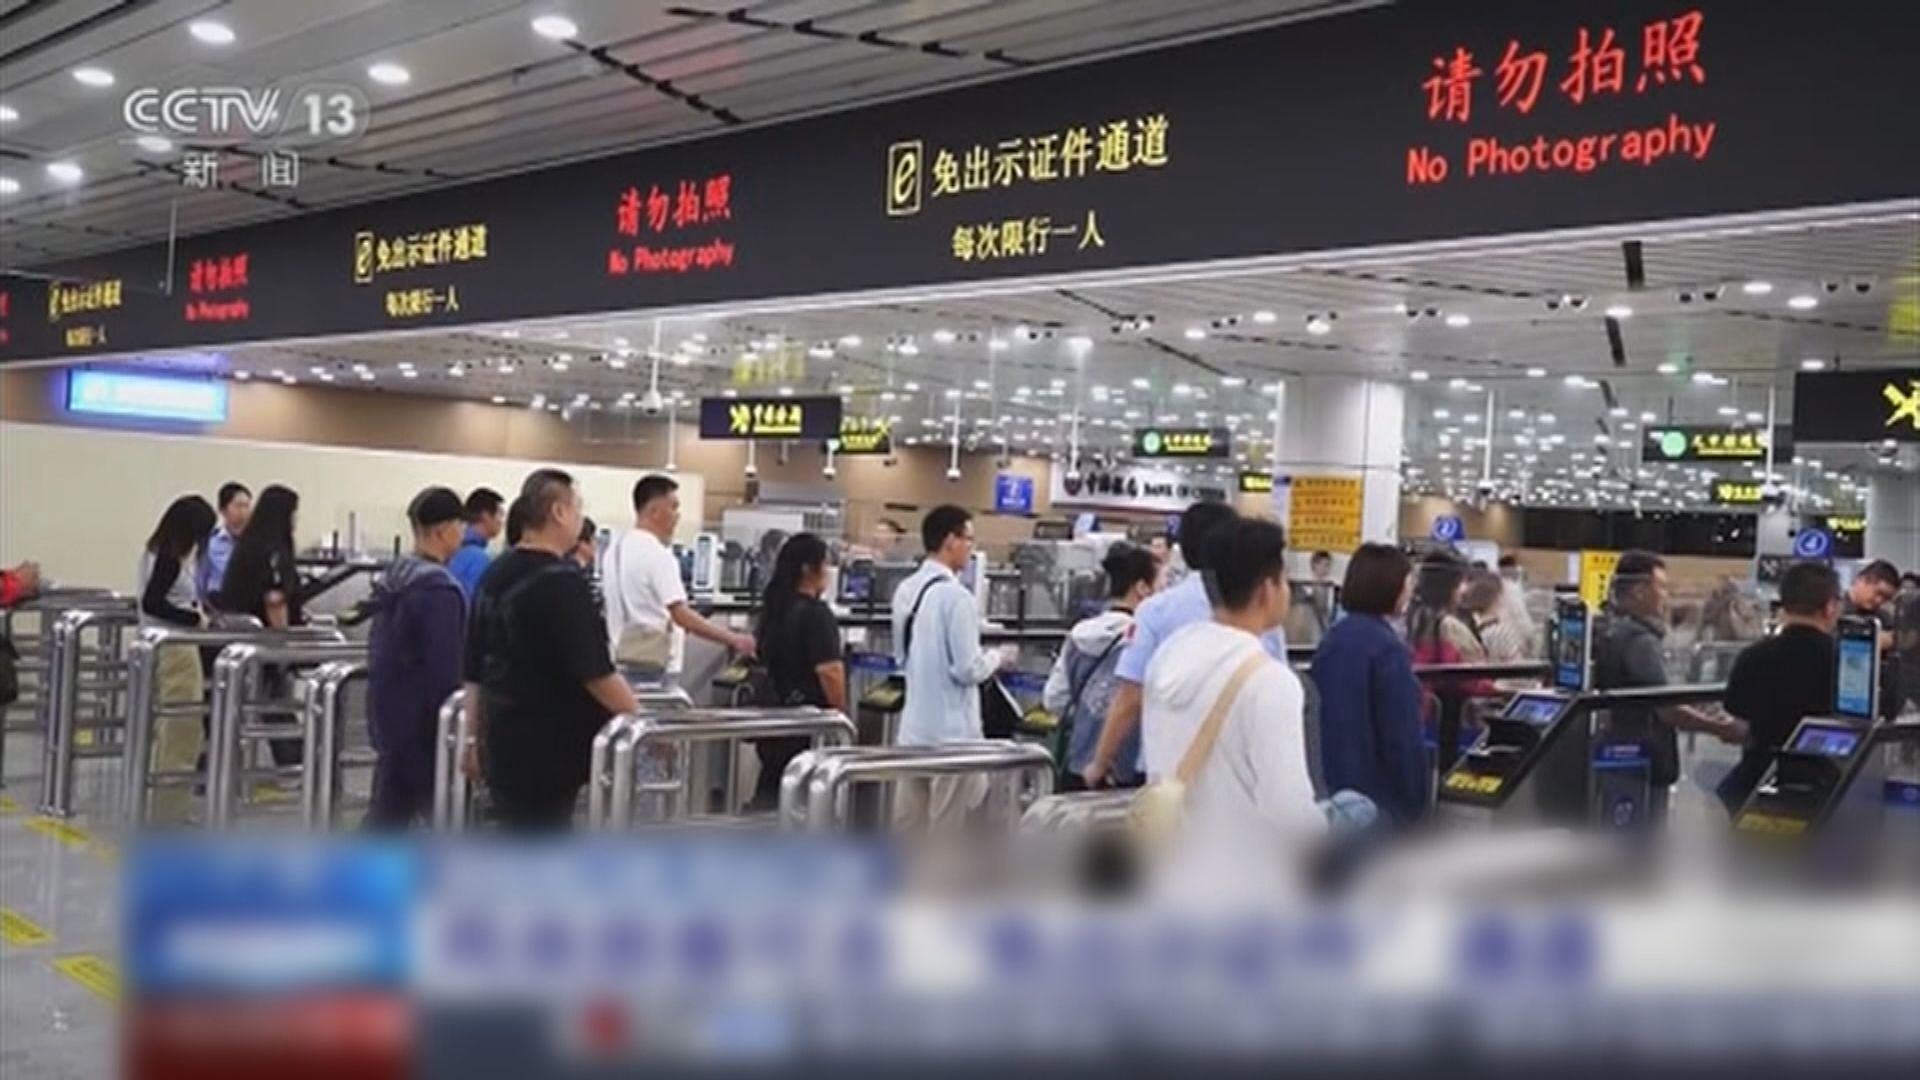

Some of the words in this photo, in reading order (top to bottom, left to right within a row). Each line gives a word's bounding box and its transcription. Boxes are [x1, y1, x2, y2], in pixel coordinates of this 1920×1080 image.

[1422, 10, 1706, 122] 请勿拍照
[932, 114, 1169, 197] 免出示证件通道
[1407, 147, 1448, 183] No
[1467, 113, 1716, 177] Photography
[618, 175, 731, 236] 请勿拍照
[953, 210, 1104, 261] 每次限行一人
[376, 225, 487, 272] 免出示证件通道
